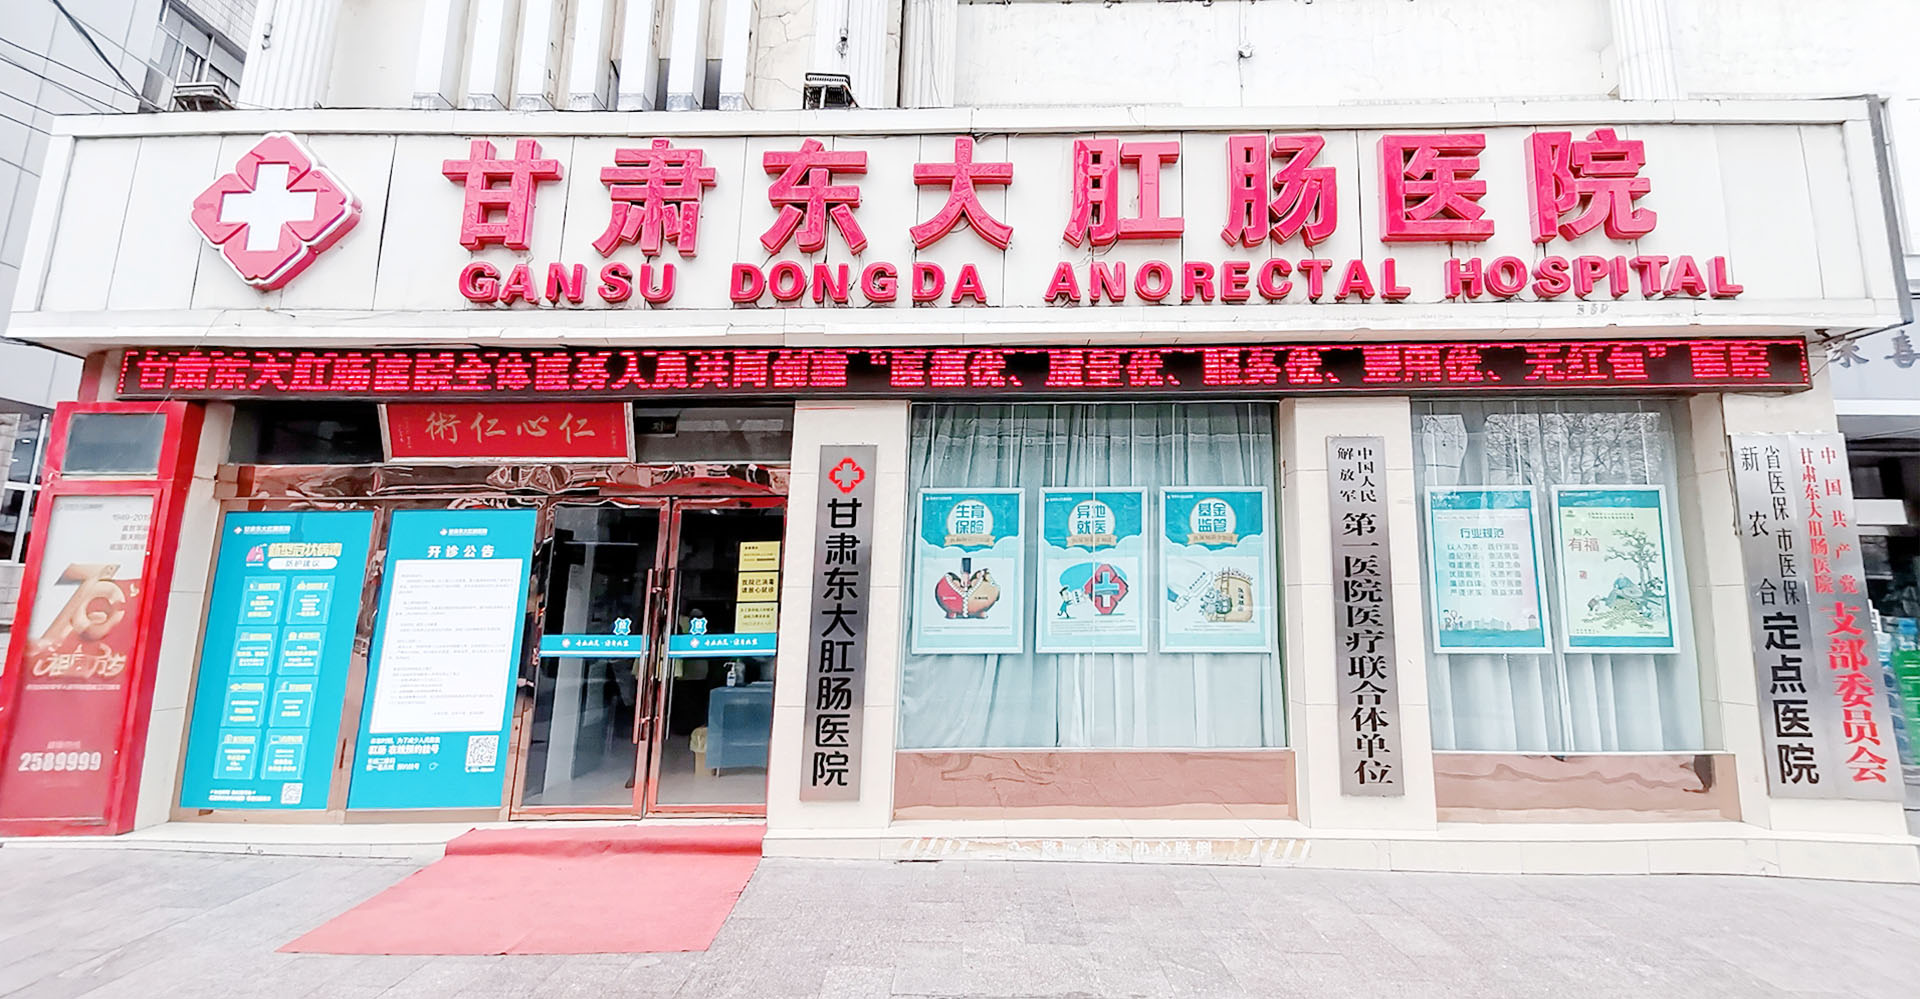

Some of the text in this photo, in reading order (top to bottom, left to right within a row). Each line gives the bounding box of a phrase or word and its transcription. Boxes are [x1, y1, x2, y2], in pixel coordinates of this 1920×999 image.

[443, 128, 1658, 257] 甘肃东大肛肠医院
[459, 255, 1743, 305] GANSU DONGDA ANORECTAL HOSPITAL
[1337, 447, 1356, 502] 解放军
[1357, 447, 1377, 503] 中国人民
[955, 520, 984, 534] 保险
[956, 504, 985, 518] 生育
[1077, 520, 1106, 534] 就医
[1198, 518, 1227, 532] 监管
[1199, 503, 1226, 516] 基金
[1460, 528, 1505, 539] 行业规范
[1800, 447, 1834, 594] 甘肃东大肛肠医院
[1820, 447, 1858, 594] 中国共产党
[427, 545, 495, 558] 开诊公告
[1568, 538, 1600, 552] 有福
[812, 498, 863, 787] 甘肃东大肛肠医院
[1342, 512, 1393, 785] 第一医院医疗联合体单位
[1762, 612, 1820, 785] 定点医院
[1820, 601, 1889, 783] 支部委员会
[18, 752, 102, 771] 2589999
